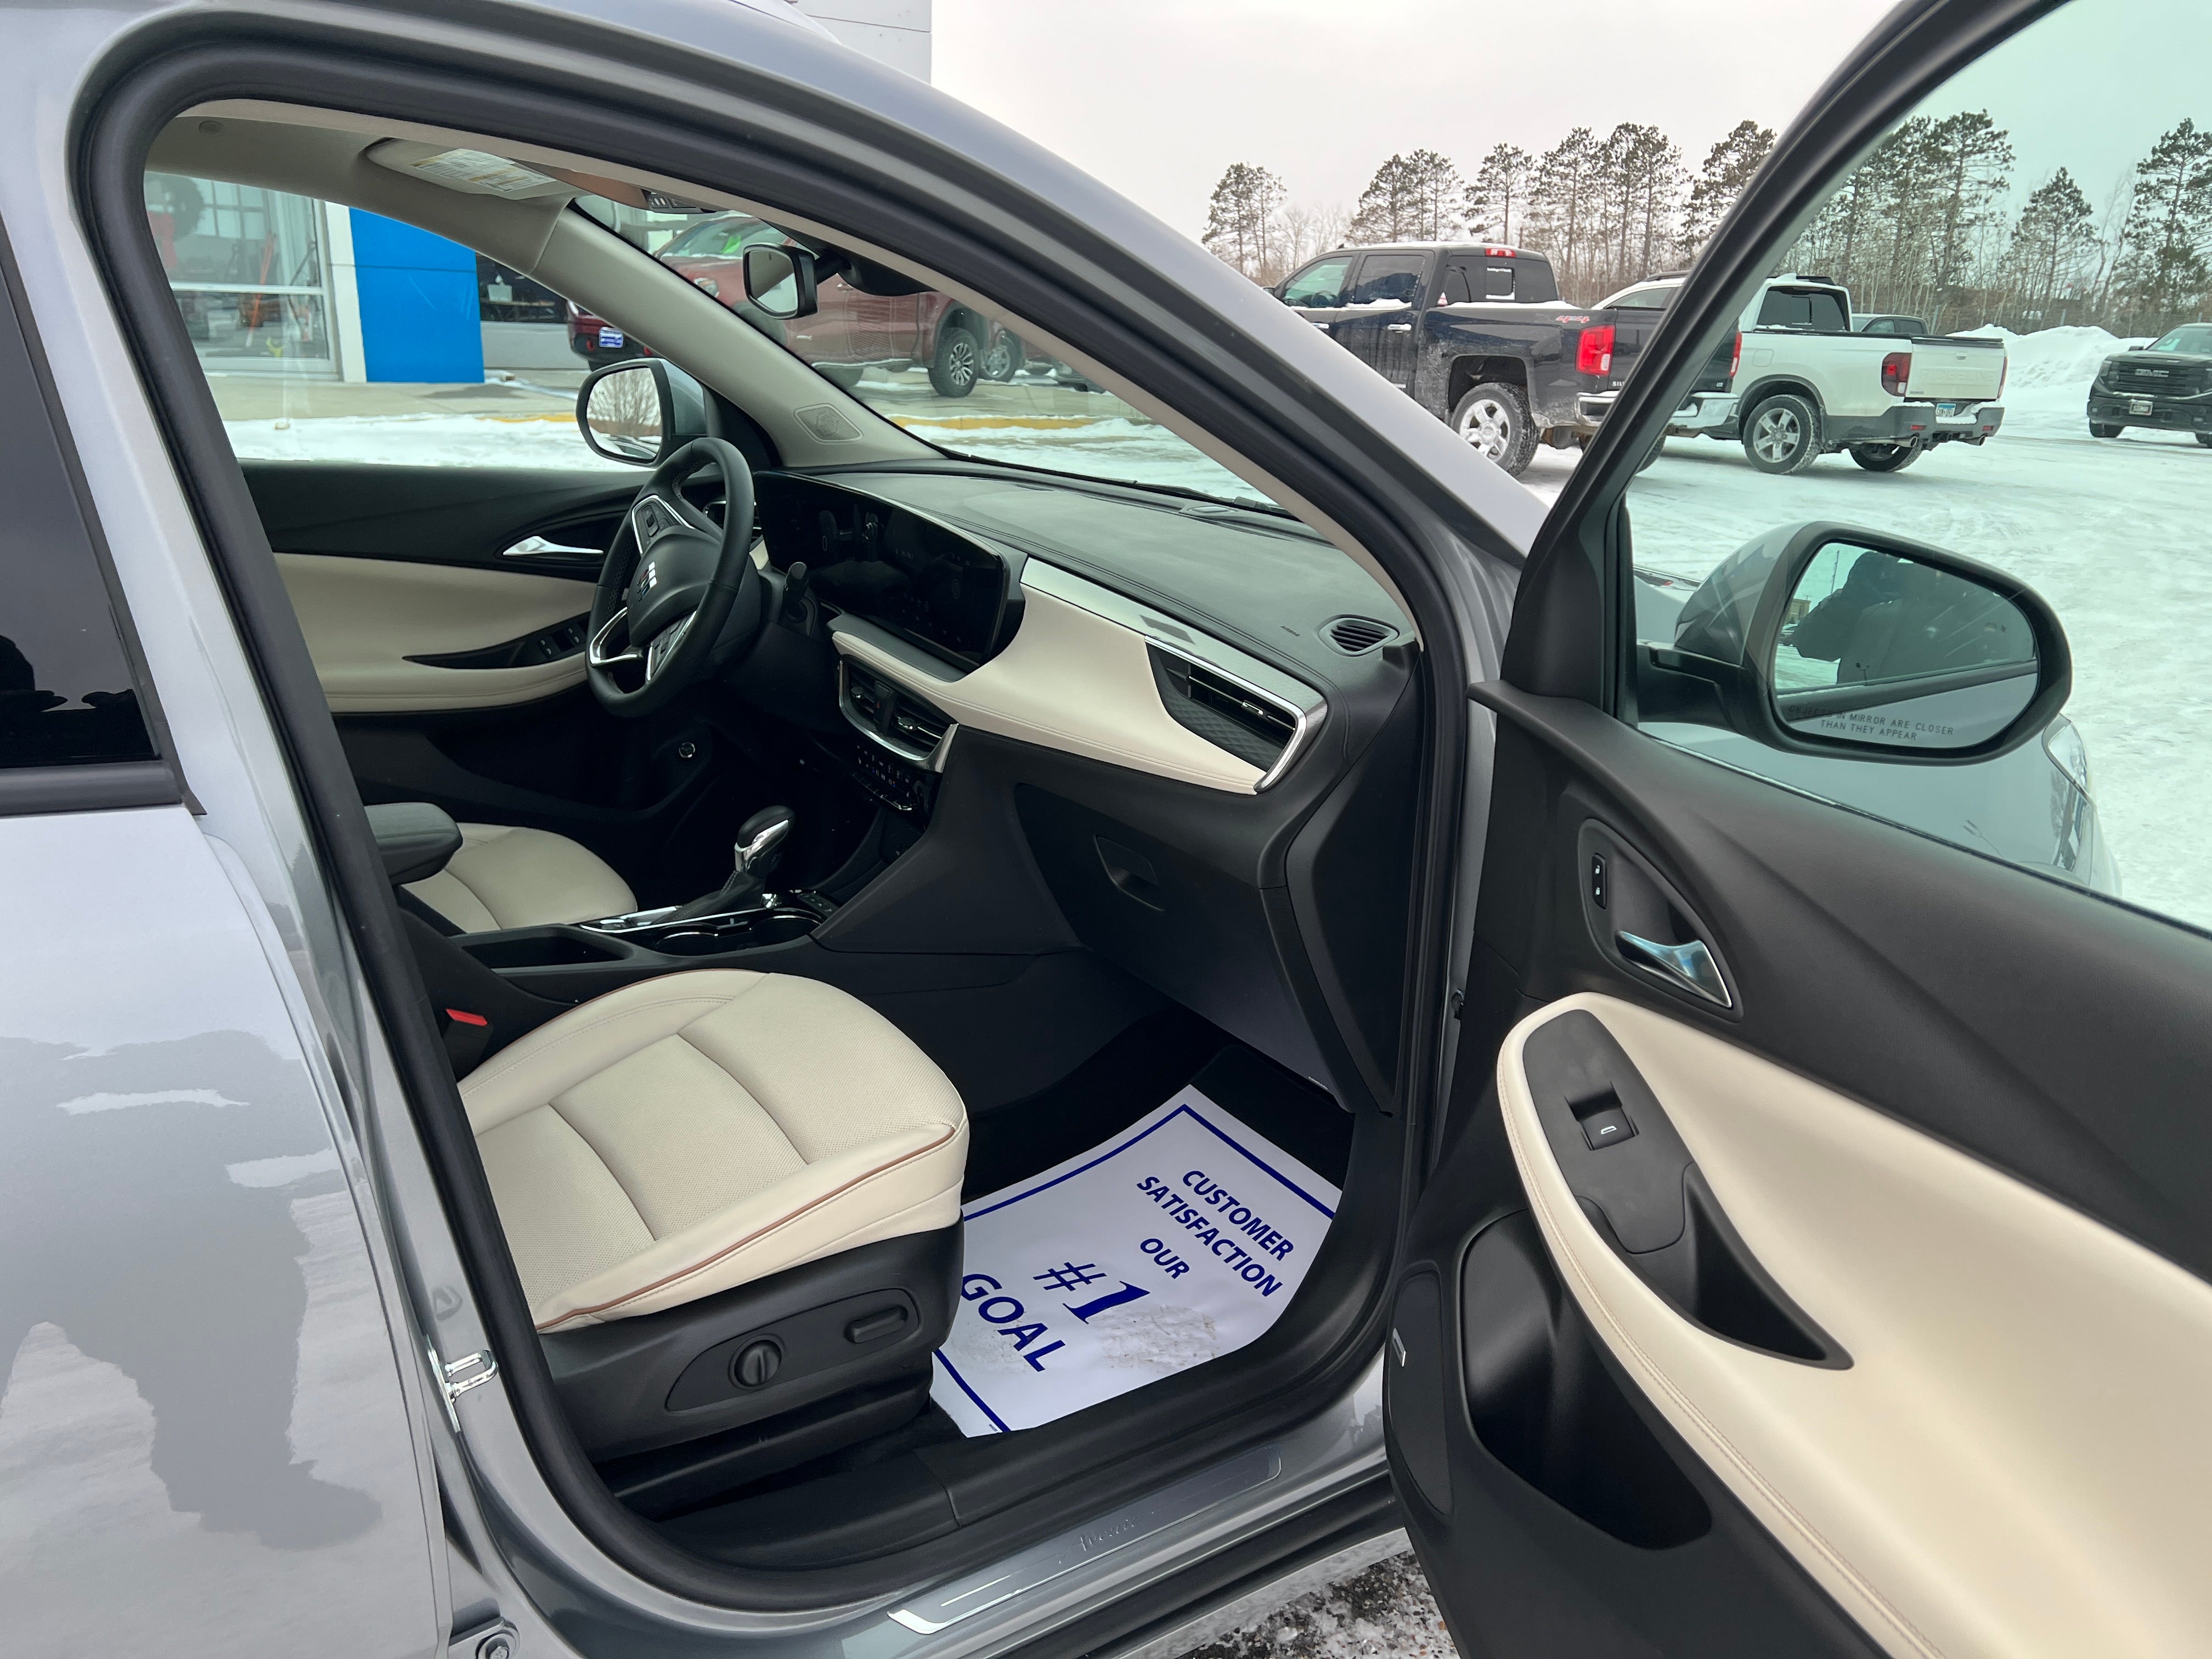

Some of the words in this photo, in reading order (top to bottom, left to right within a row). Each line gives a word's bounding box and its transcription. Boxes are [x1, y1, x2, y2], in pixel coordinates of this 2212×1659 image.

[2135, 368, 2170, 378] GMC
[1821, 719, 1847, 730] THAN
[1851, 723, 1875, 734] THEY
[1878, 729, 1917, 741] APPEAR
[1850, 713, 1886, 725] MIRROR
[1891, 719, 1910, 729] ARE
[1916, 723, 1954, 736] CLOSER
[1136, 1176, 1282, 1296] SATISFACTION
[1183, 1170, 1294, 1261] CUSTOMER
[1140, 1238, 1190, 1279] OUR
[1033, 1262, 1150, 1324] #1
[961, 1273, 1066, 1372] GOAL
